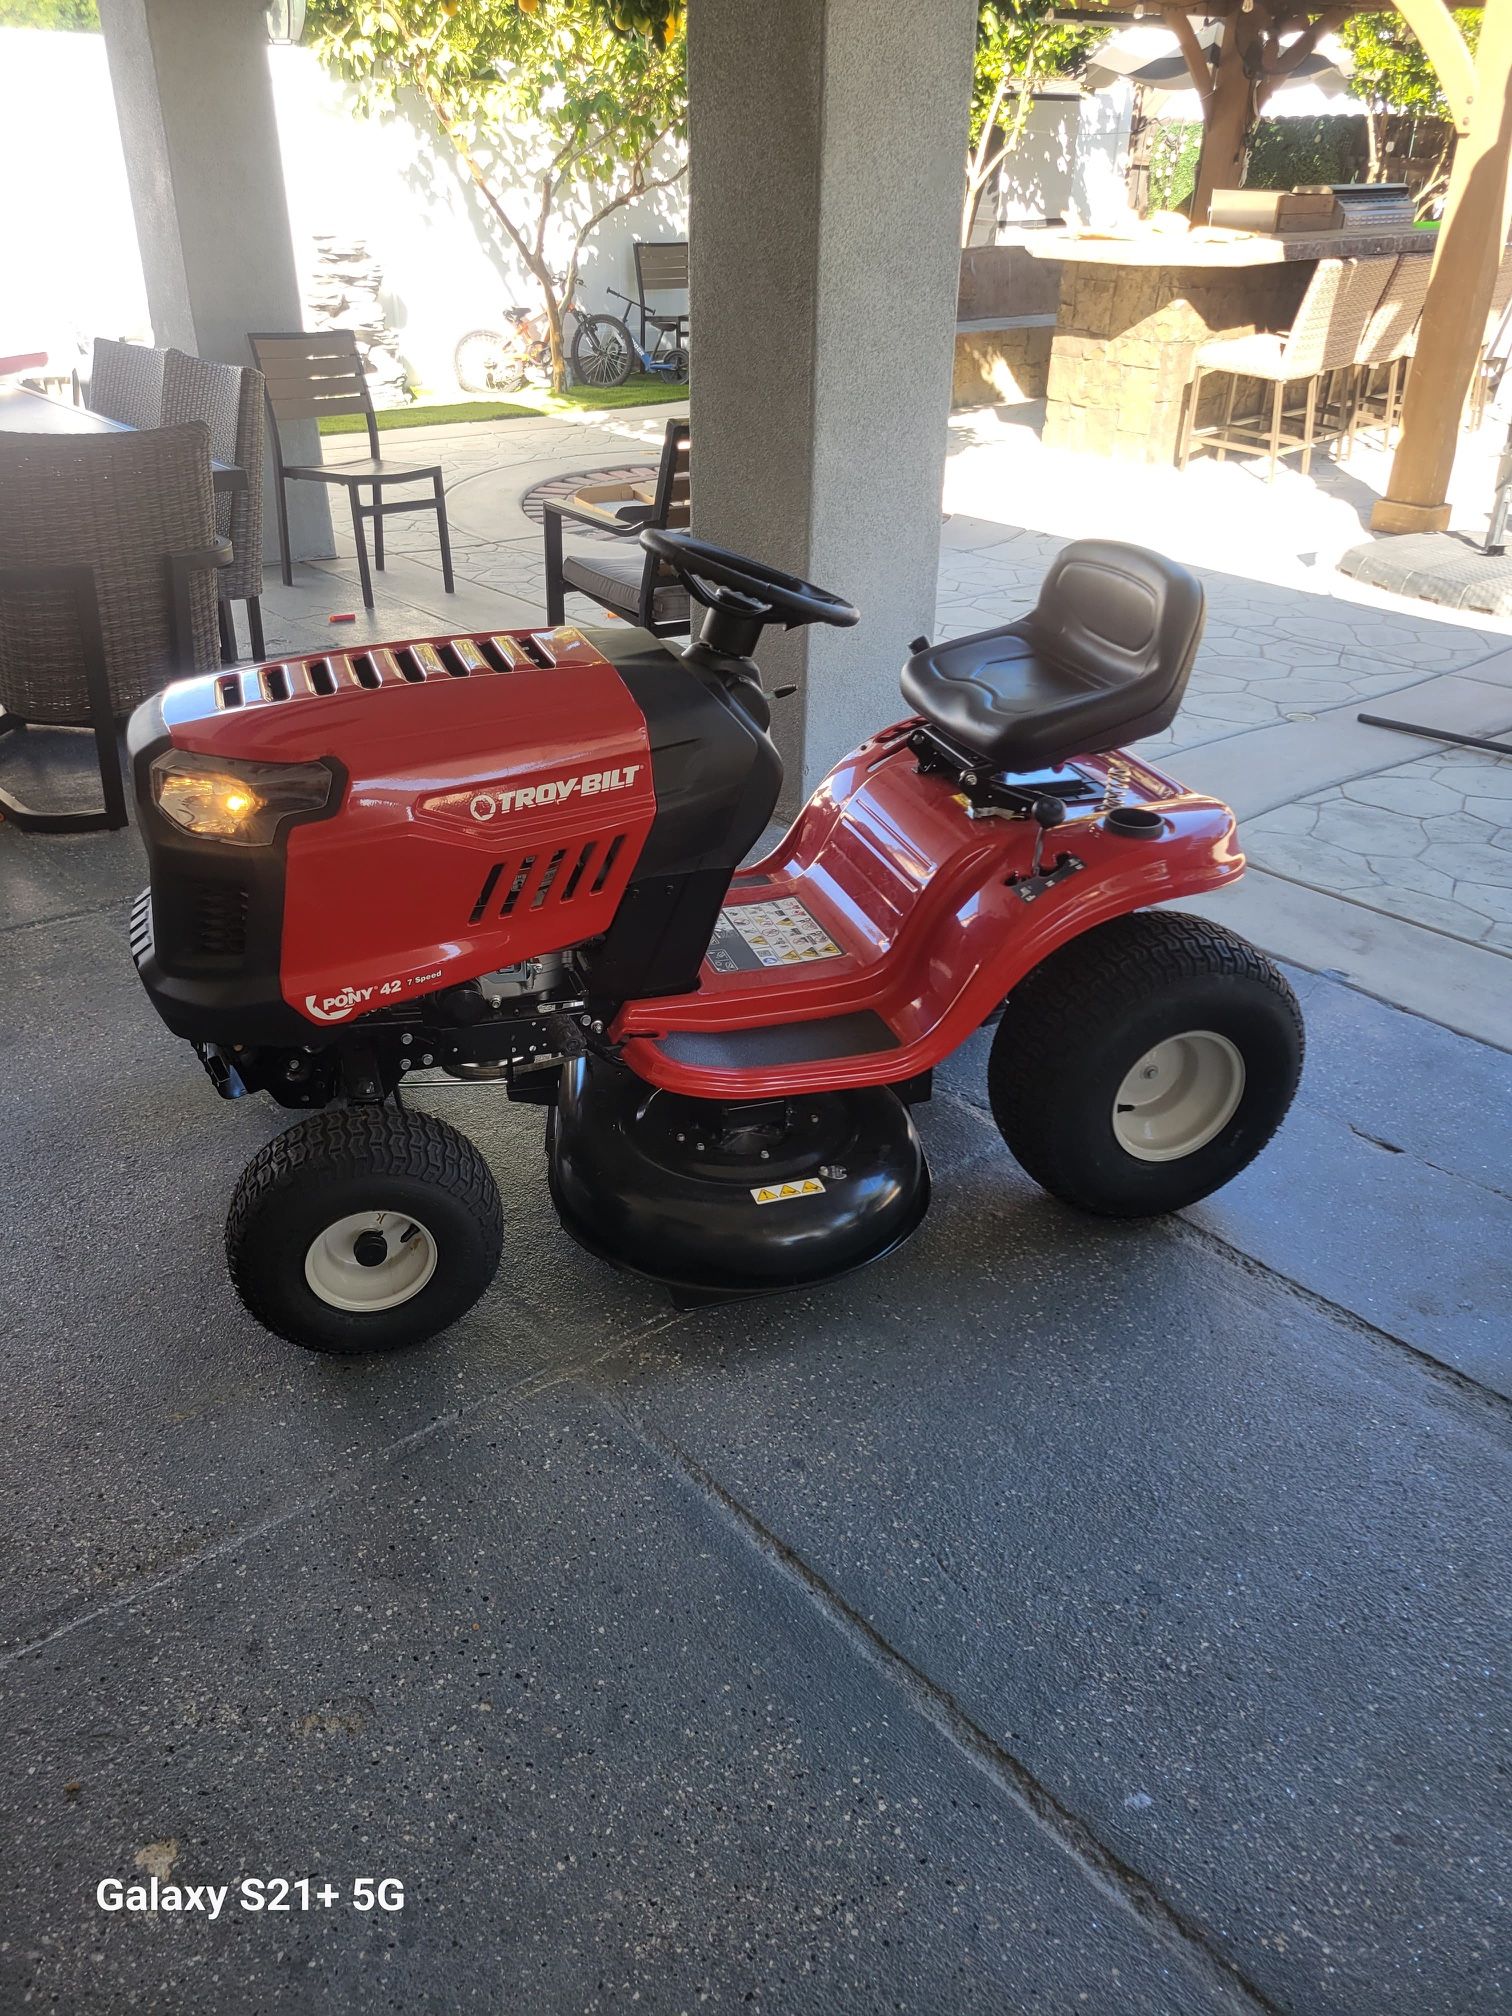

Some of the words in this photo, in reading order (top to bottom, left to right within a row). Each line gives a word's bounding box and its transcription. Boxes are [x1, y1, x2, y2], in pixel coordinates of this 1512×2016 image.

[498, 764, 641, 814] TROY-BILT
[322, 986, 373, 1010] PONY
[380, 979, 402, 995] 42
[407, 978, 413, 986] 7
[414, 970, 442, 984] Speed
